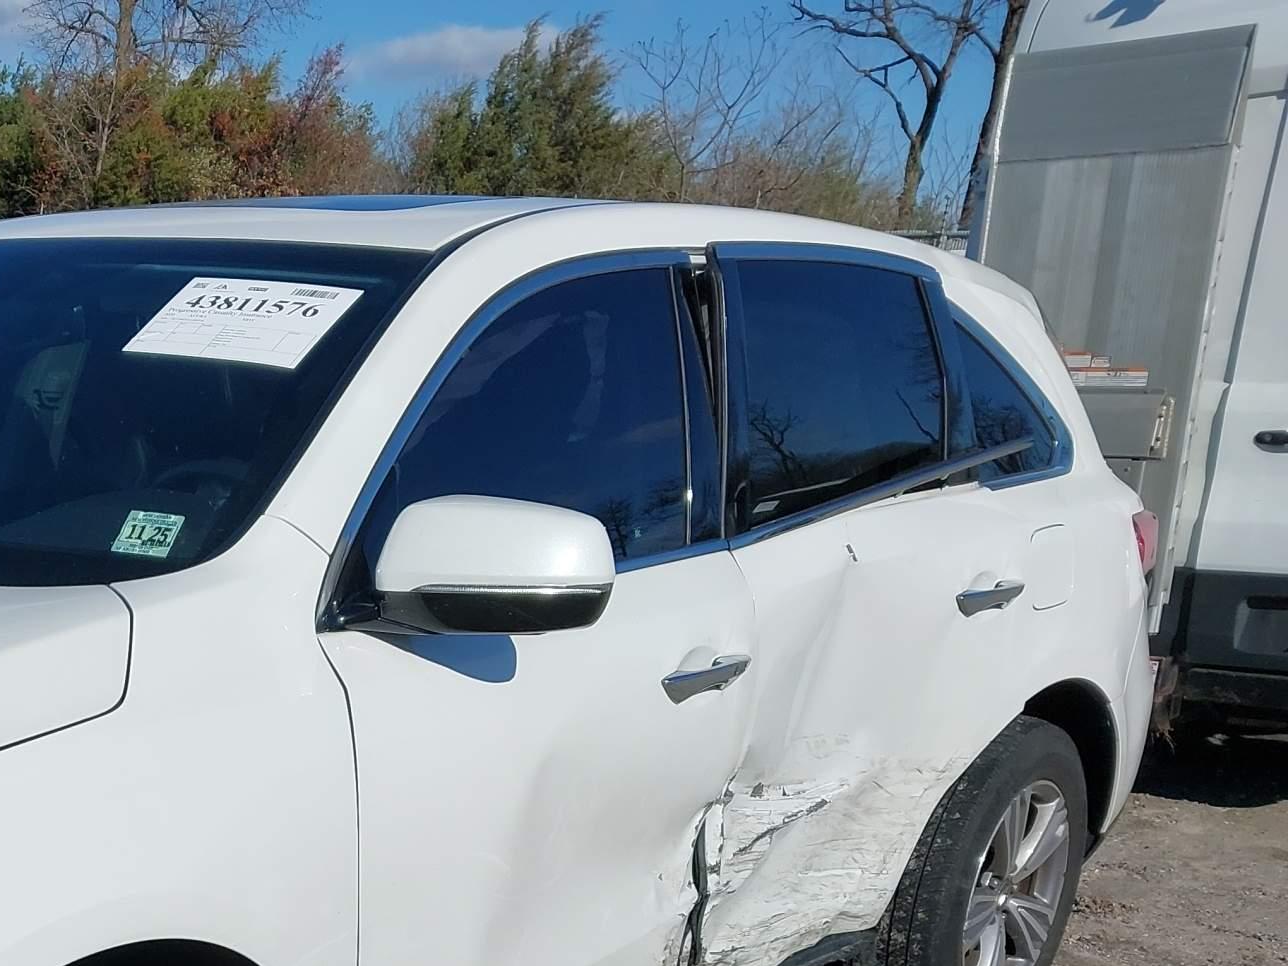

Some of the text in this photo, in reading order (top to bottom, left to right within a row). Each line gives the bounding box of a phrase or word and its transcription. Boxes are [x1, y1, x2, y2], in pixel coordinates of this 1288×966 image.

[185, 294, 325, 318] 43811576
[125, 523, 174, 543] 11 25
